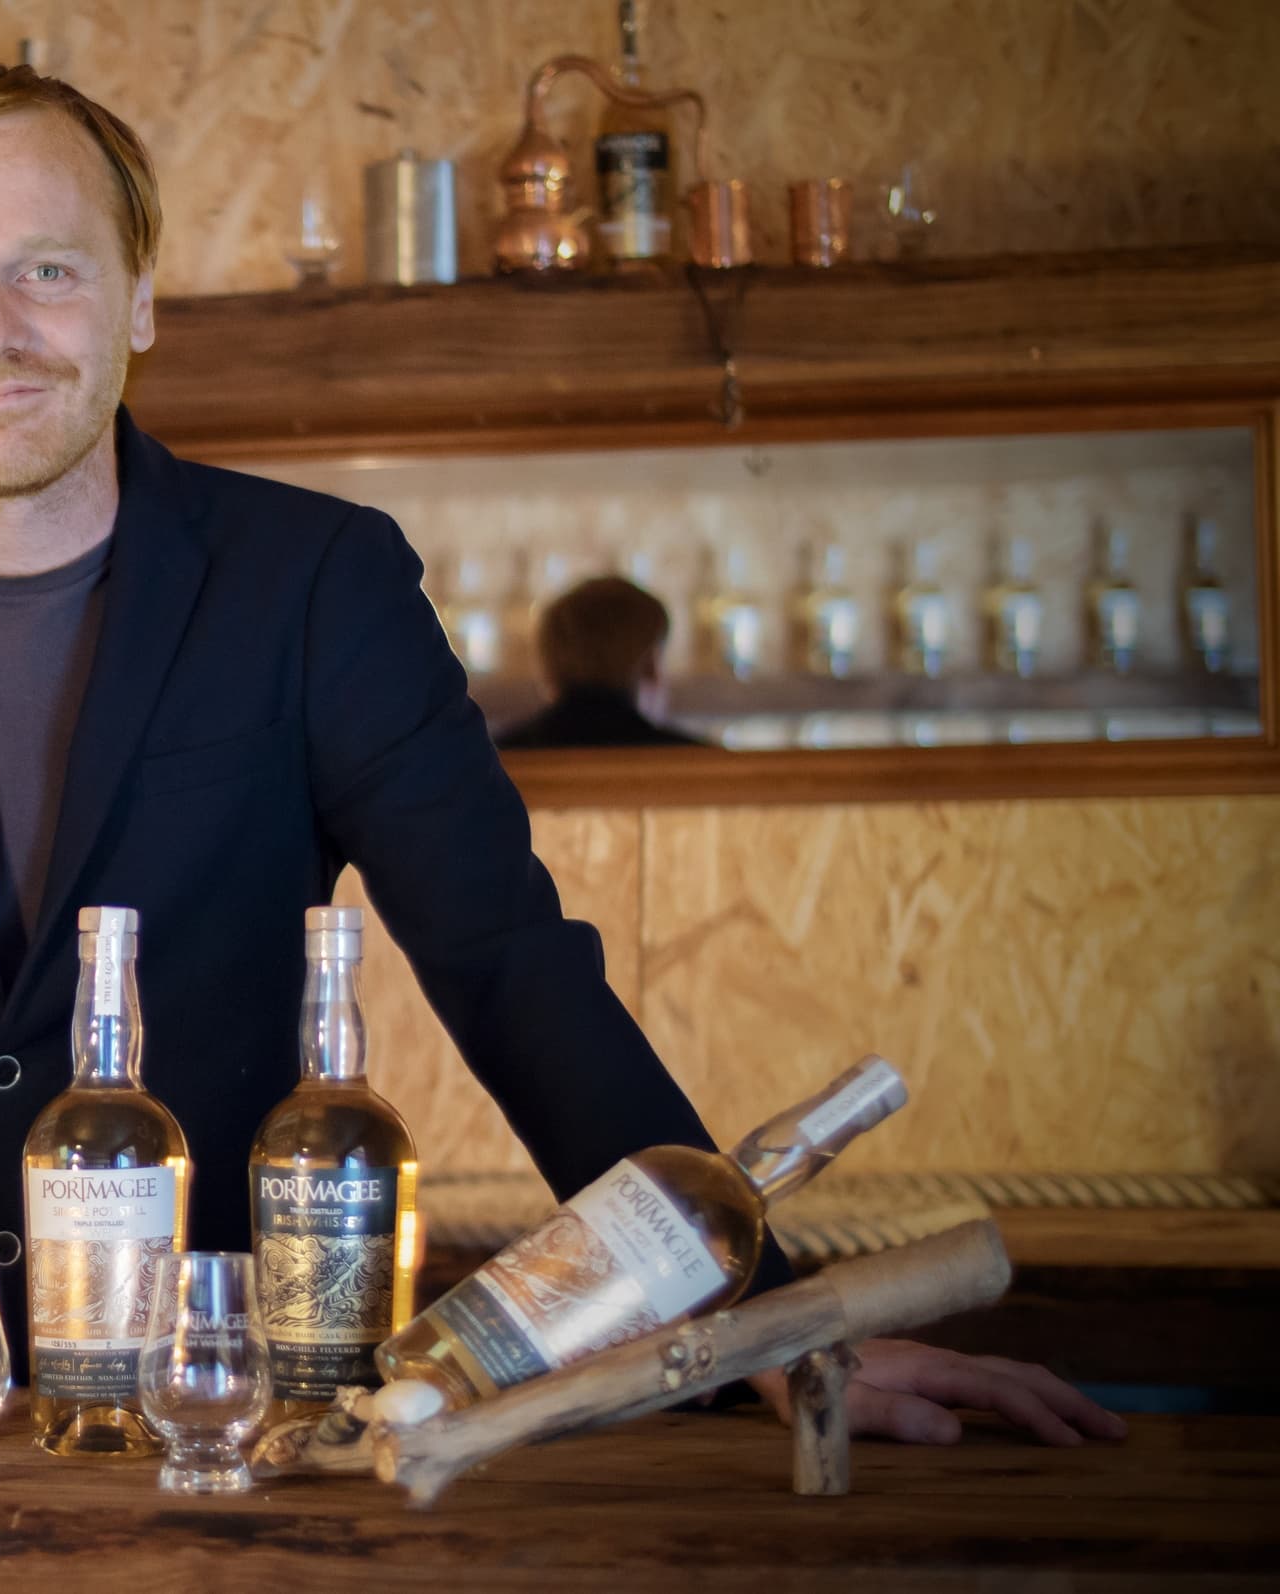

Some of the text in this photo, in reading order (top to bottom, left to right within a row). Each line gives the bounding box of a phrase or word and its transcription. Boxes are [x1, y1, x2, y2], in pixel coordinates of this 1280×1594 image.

[42, 1176, 158, 1202] PORTMAGEE
[261, 1175, 382, 1206] PORTMAGEE
[273, 1214, 364, 1228] IRISH WHISEY
[275, 1343, 361, 1354] NON-CHILL FILTERED
